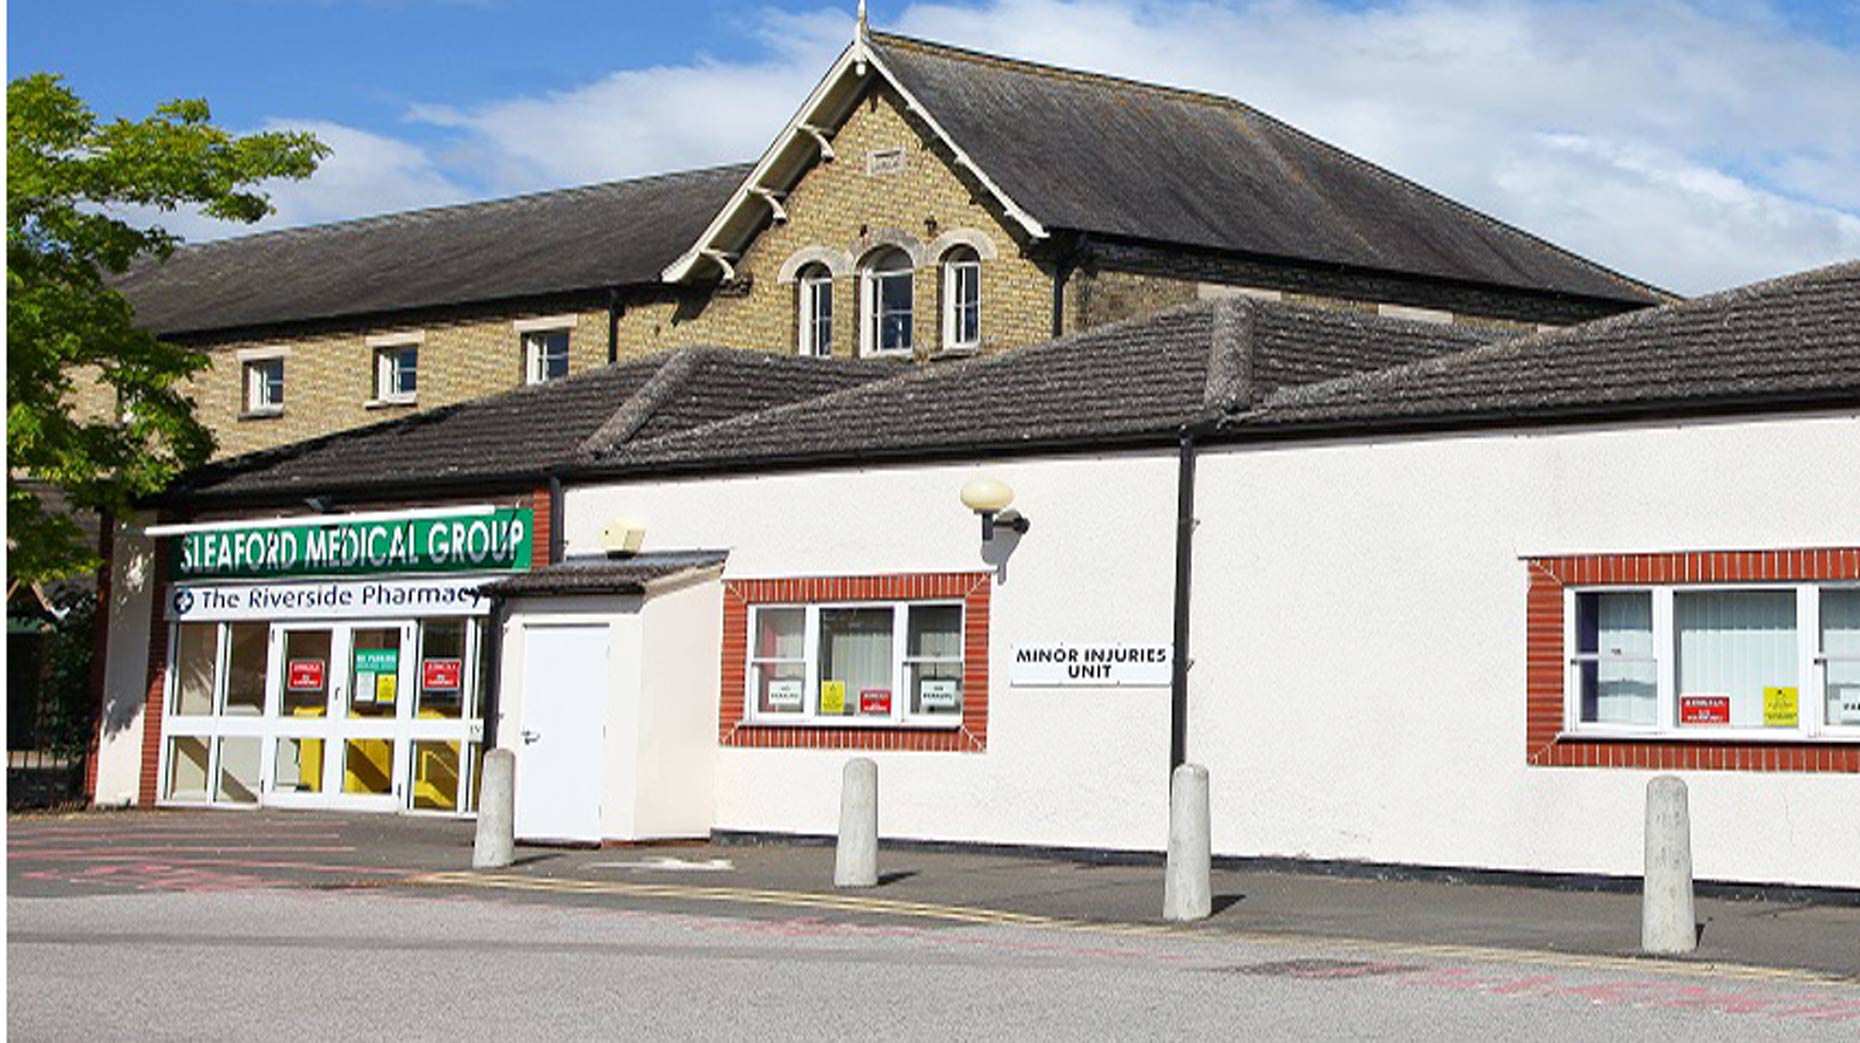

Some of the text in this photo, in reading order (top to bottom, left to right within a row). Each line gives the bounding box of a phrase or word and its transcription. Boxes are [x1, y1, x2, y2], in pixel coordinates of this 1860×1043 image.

[180, 519, 525, 572] SLEAFORD MEDICAL GROUP
[201, 583, 482, 610] The Riverside Pharmacy
[1016, 648, 1167, 663] MINOR INJURIES
[1067, 664, 1112, 679] UNIT
